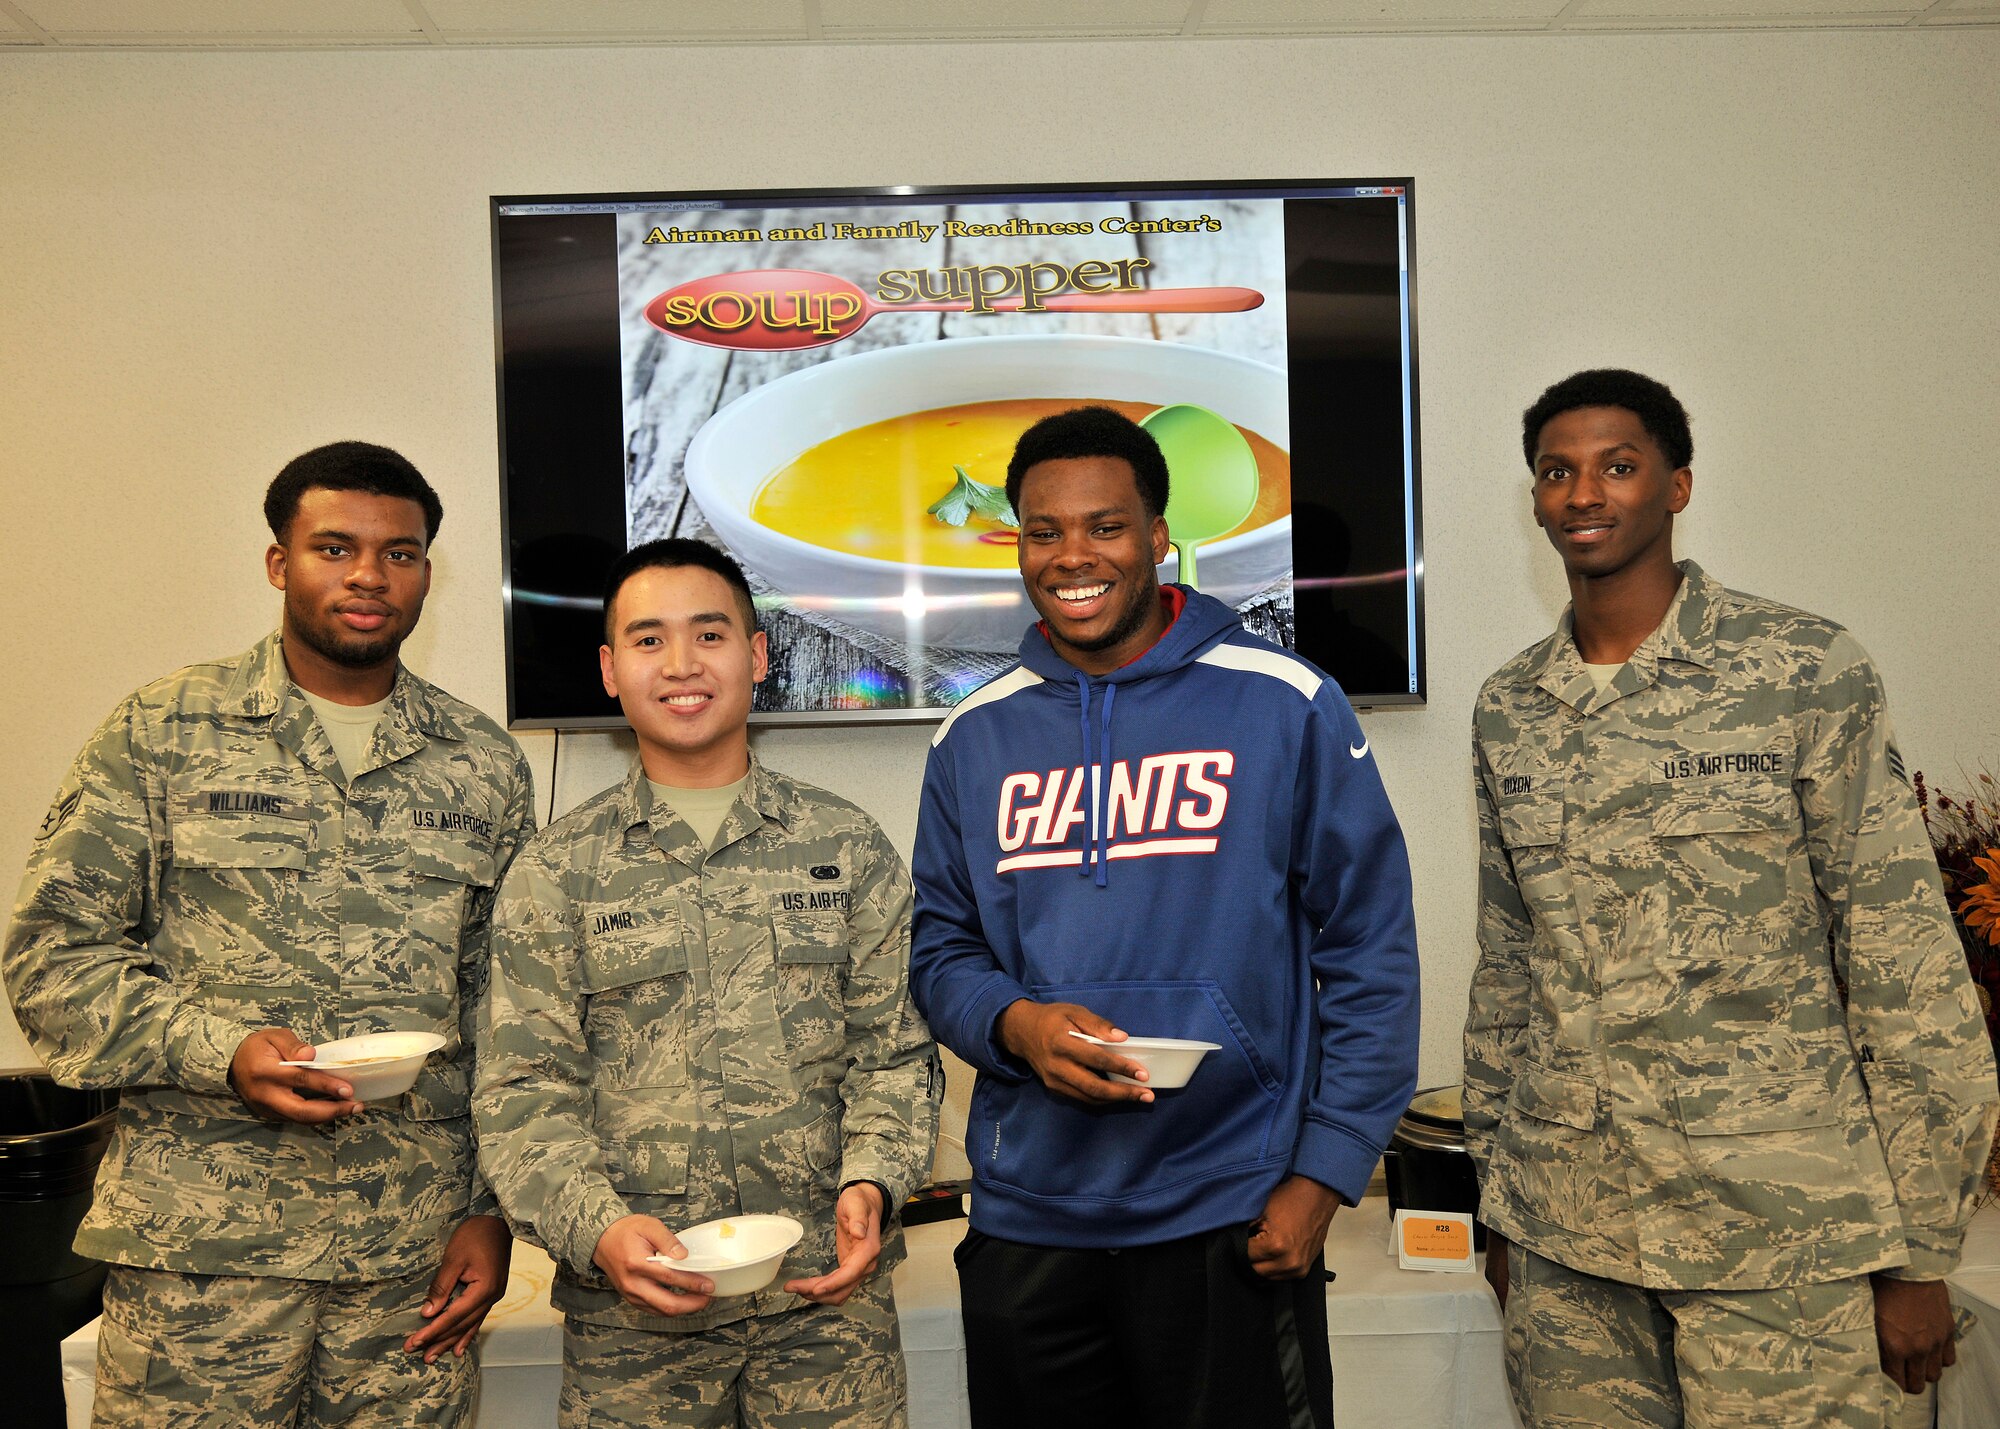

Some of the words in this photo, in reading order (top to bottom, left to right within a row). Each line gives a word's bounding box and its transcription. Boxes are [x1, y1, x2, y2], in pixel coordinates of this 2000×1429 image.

[644, 227, 764, 246] Airman
[768, 224, 828, 242] and
[834, 220, 938, 244] Family
[943, 219, 1093, 238] Readiness
[1099, 214, 1222, 235] Center's
[664, 289, 862, 334] soup
[877, 256, 1151, 314] supper
[1664, 762, 1695, 780] U.S.
[1697, 758, 1723, 777] AIR
[1725, 753, 1782, 775] FORCE
[1504, 775, 1531, 795] DIXON
[209, 792, 282, 814] WILLIAMS
[997, 749, 1235, 853] GIANTS
[413, 809, 439, 828] U.S.
[440, 811, 462, 830] AIR
[463, 814, 494, 840] FORCE
[782, 893, 808, 911] U.S.
[809, 892, 831, 909] AIR
[593, 911, 633, 936] JAMIR
